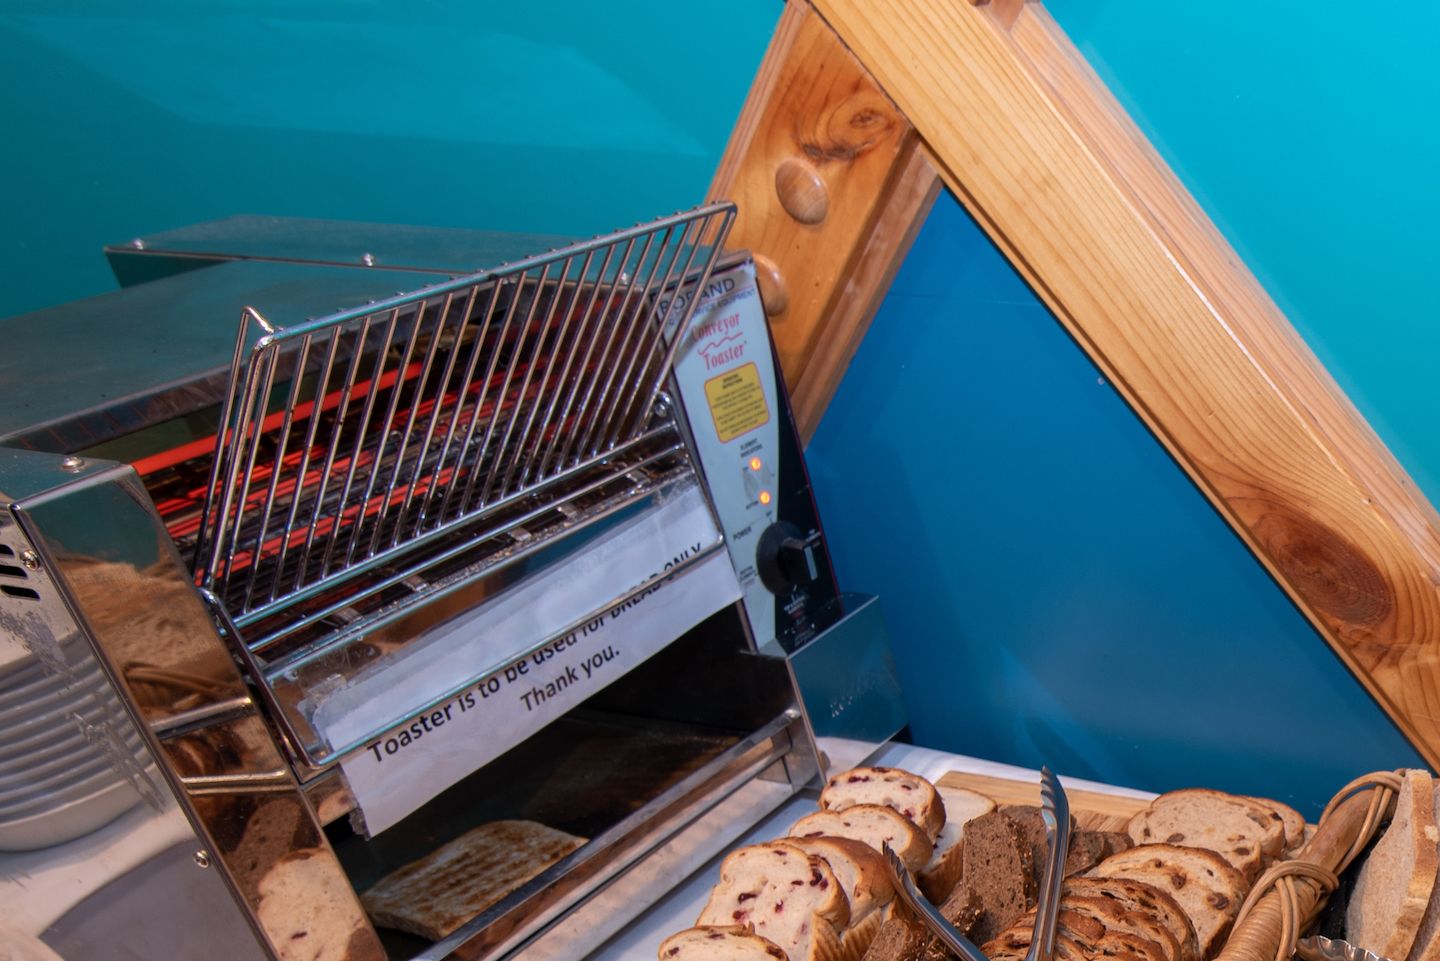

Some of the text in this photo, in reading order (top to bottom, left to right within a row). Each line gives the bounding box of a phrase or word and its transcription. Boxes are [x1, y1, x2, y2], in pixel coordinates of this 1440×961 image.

[692, 312, 740, 341] Conveyor
[703, 344, 744, 371] Toaster
[520, 645, 620, 712] Thank you.
[366, 703, 452, 763] Toaster
[456, 693, 476, 713] is
[477, 676, 501, 699] to
[504, 658, 530, 684] be
